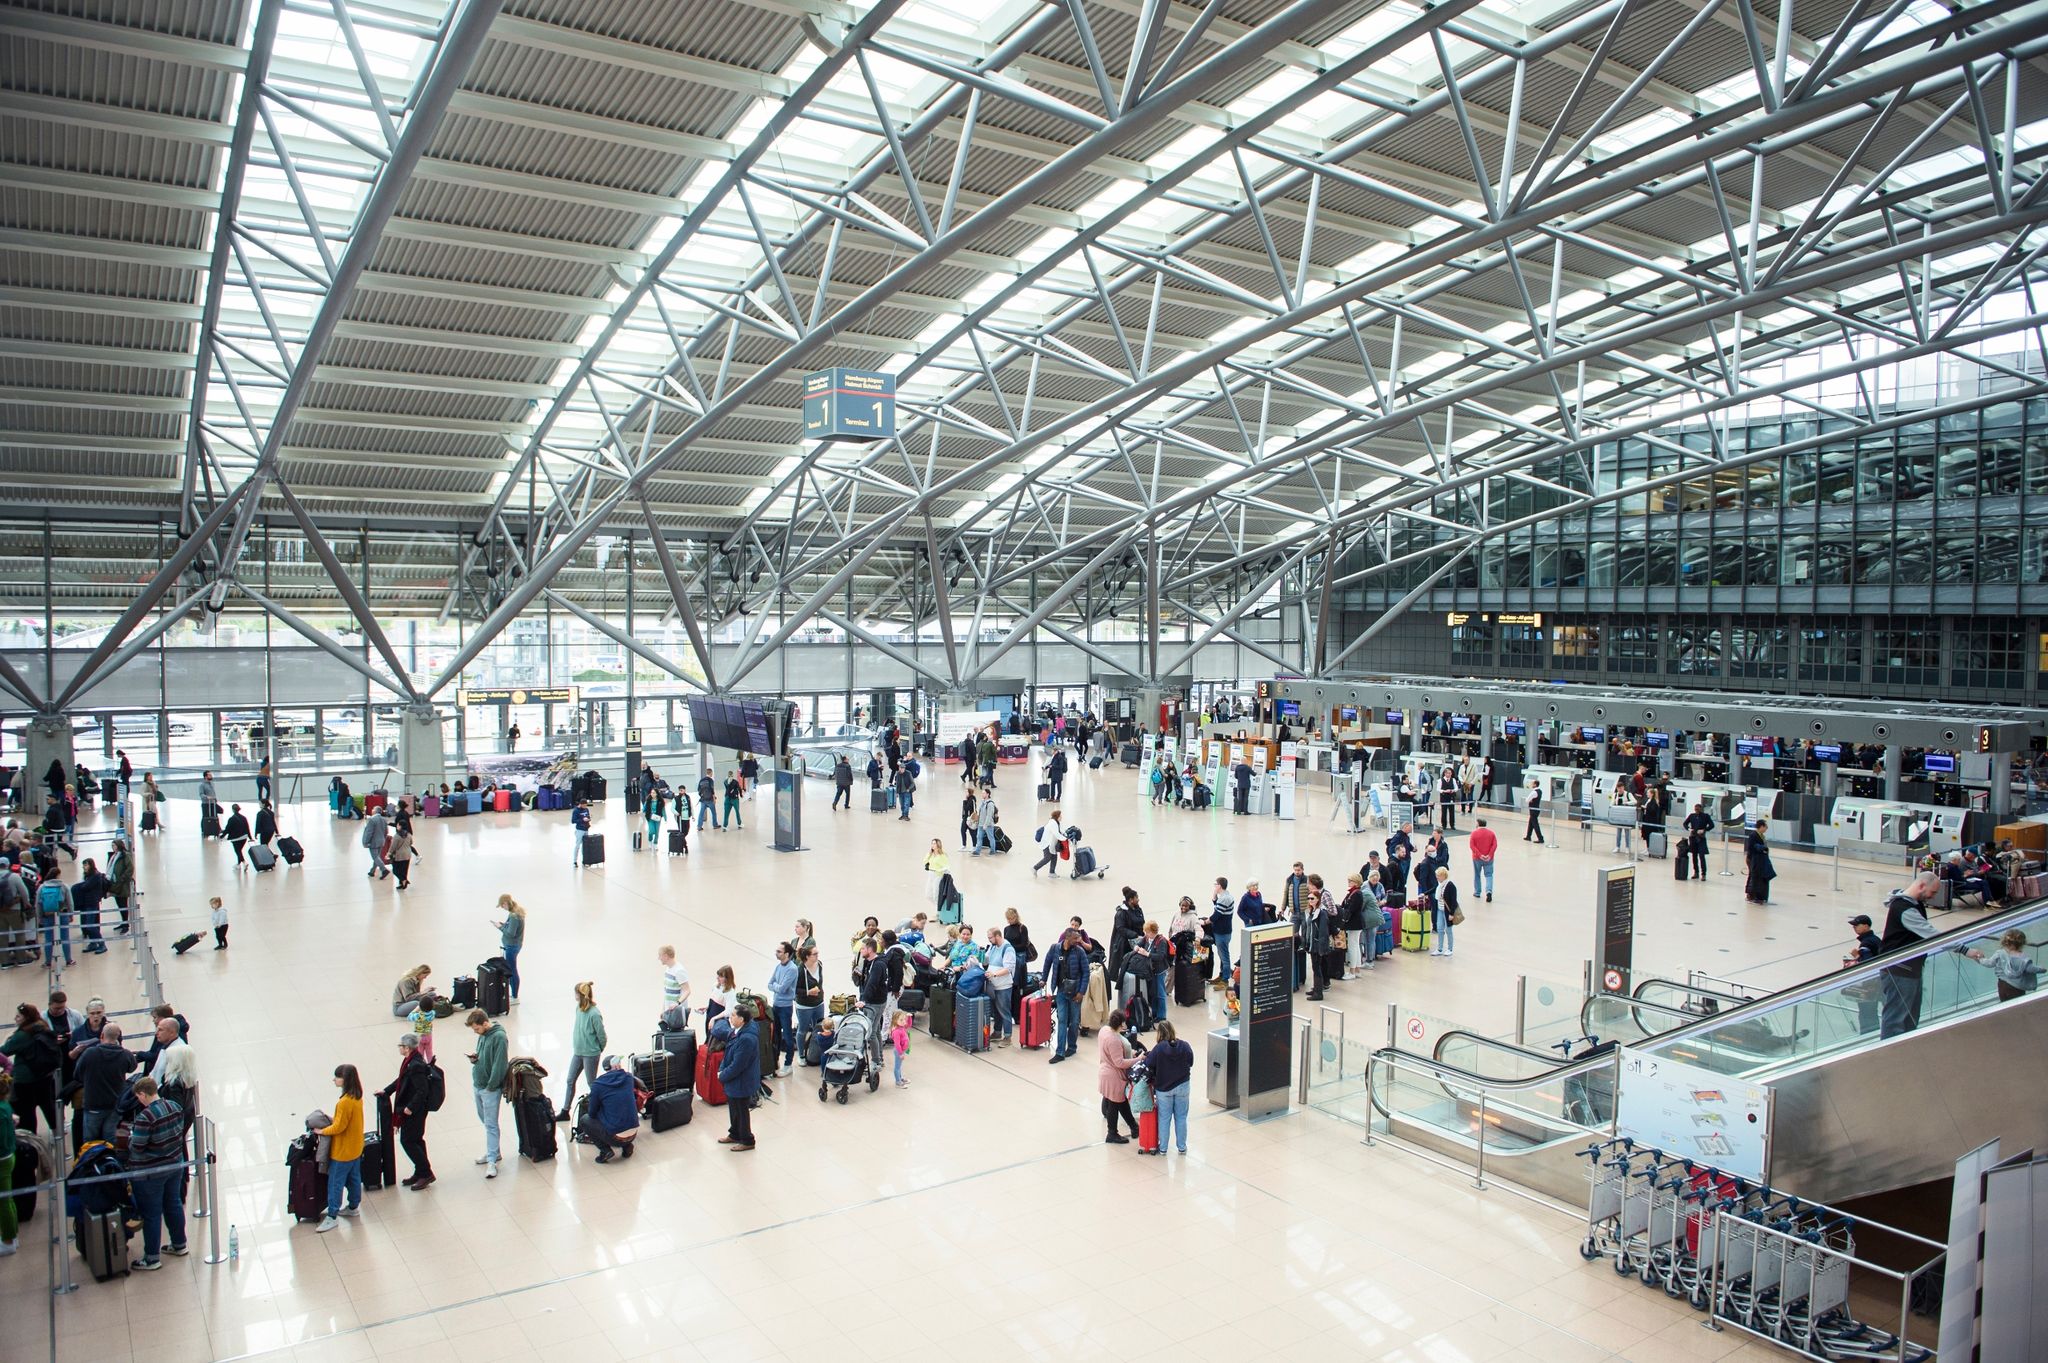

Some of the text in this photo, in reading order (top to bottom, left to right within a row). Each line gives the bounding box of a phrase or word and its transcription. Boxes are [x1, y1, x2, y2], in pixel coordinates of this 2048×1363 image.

[822, 399, 828, 426] 1
[844, 401, 882, 428] Terminal 1
[1261, 683, 1267, 694] 3
[1983, 729, 1989, 745] 3
